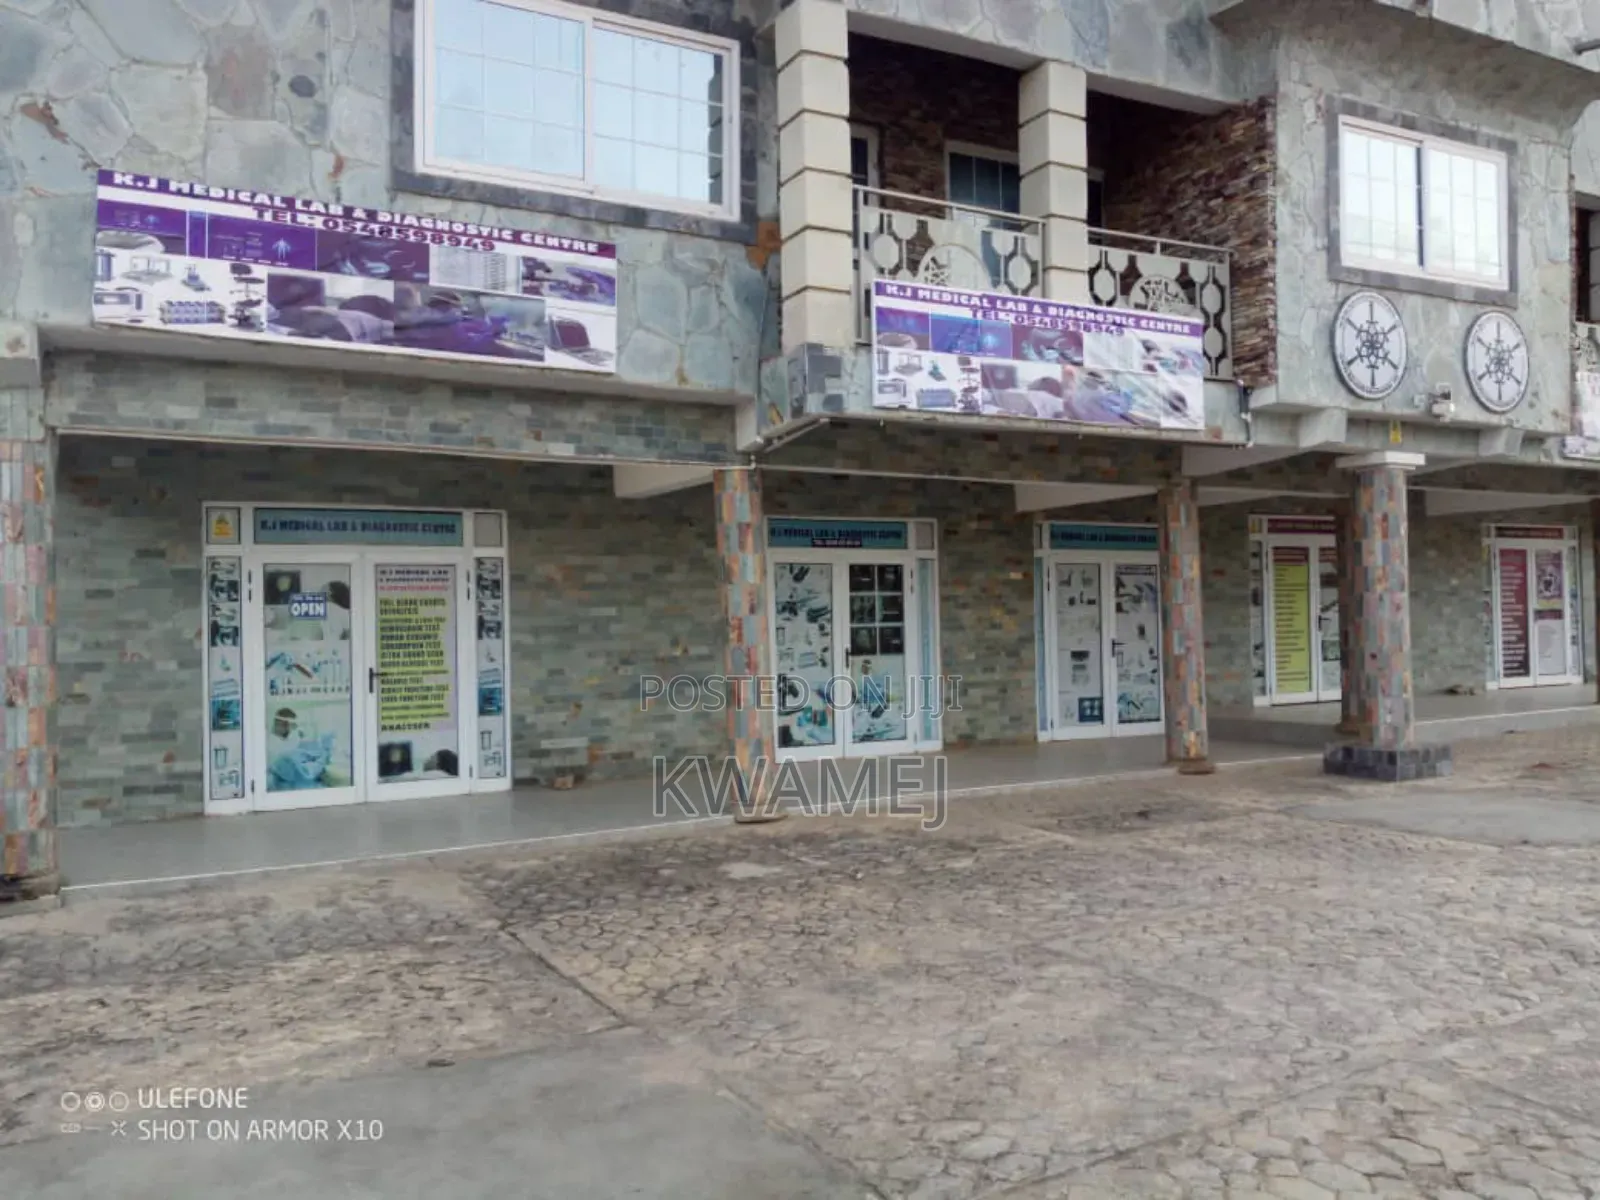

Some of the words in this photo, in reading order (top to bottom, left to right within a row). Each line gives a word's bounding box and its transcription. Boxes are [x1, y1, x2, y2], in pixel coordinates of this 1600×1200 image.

[112, 172, 158, 189] K.J
[169, 179, 288, 208] MEDICAL
[295, 196, 344, 215] LAB
[352, 207, 368, 220] &
[377, 212, 515, 241] DIAGNOSTIC
[520, 233, 600, 253] CENTRE
[885, 285, 912, 297] K.J
[917, 288, 991, 308] MEDICAL
[996, 299, 1028, 312] LAB
[1048, 306, 1136, 327] DIAGNOSTIC
[1139, 319, 1191, 334] CENTRE
[279, 520, 324, 532] MEDICAL
[290, 602, 325, 617] OPEN
